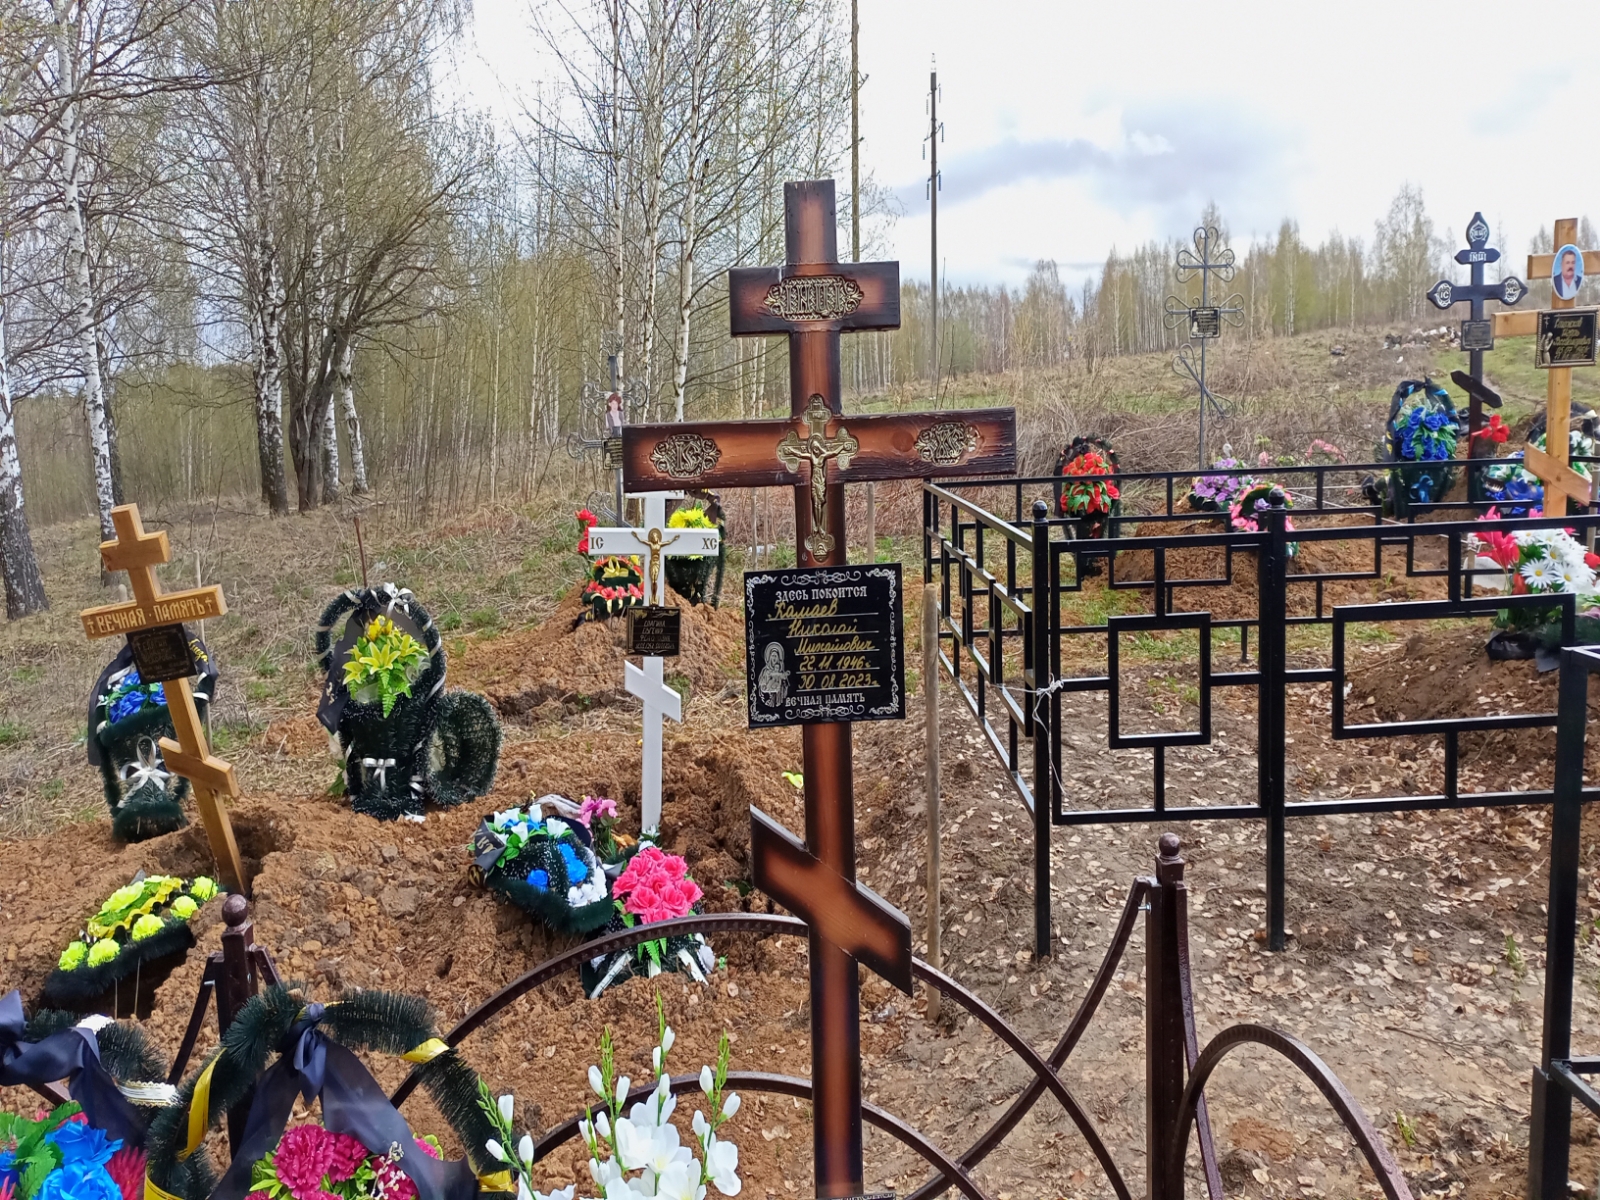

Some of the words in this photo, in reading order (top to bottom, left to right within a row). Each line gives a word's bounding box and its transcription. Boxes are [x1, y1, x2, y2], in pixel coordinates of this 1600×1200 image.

[96, 608, 147, 634] ВЕЧНАЯ
[153, 598, 206, 623] ПАМЯТЬ
[788, 617, 858, 637] Николай
[785, 695, 823, 707] ВЕЧНАЯ
[825, 692, 866, 705] ПАМЯТЬ
